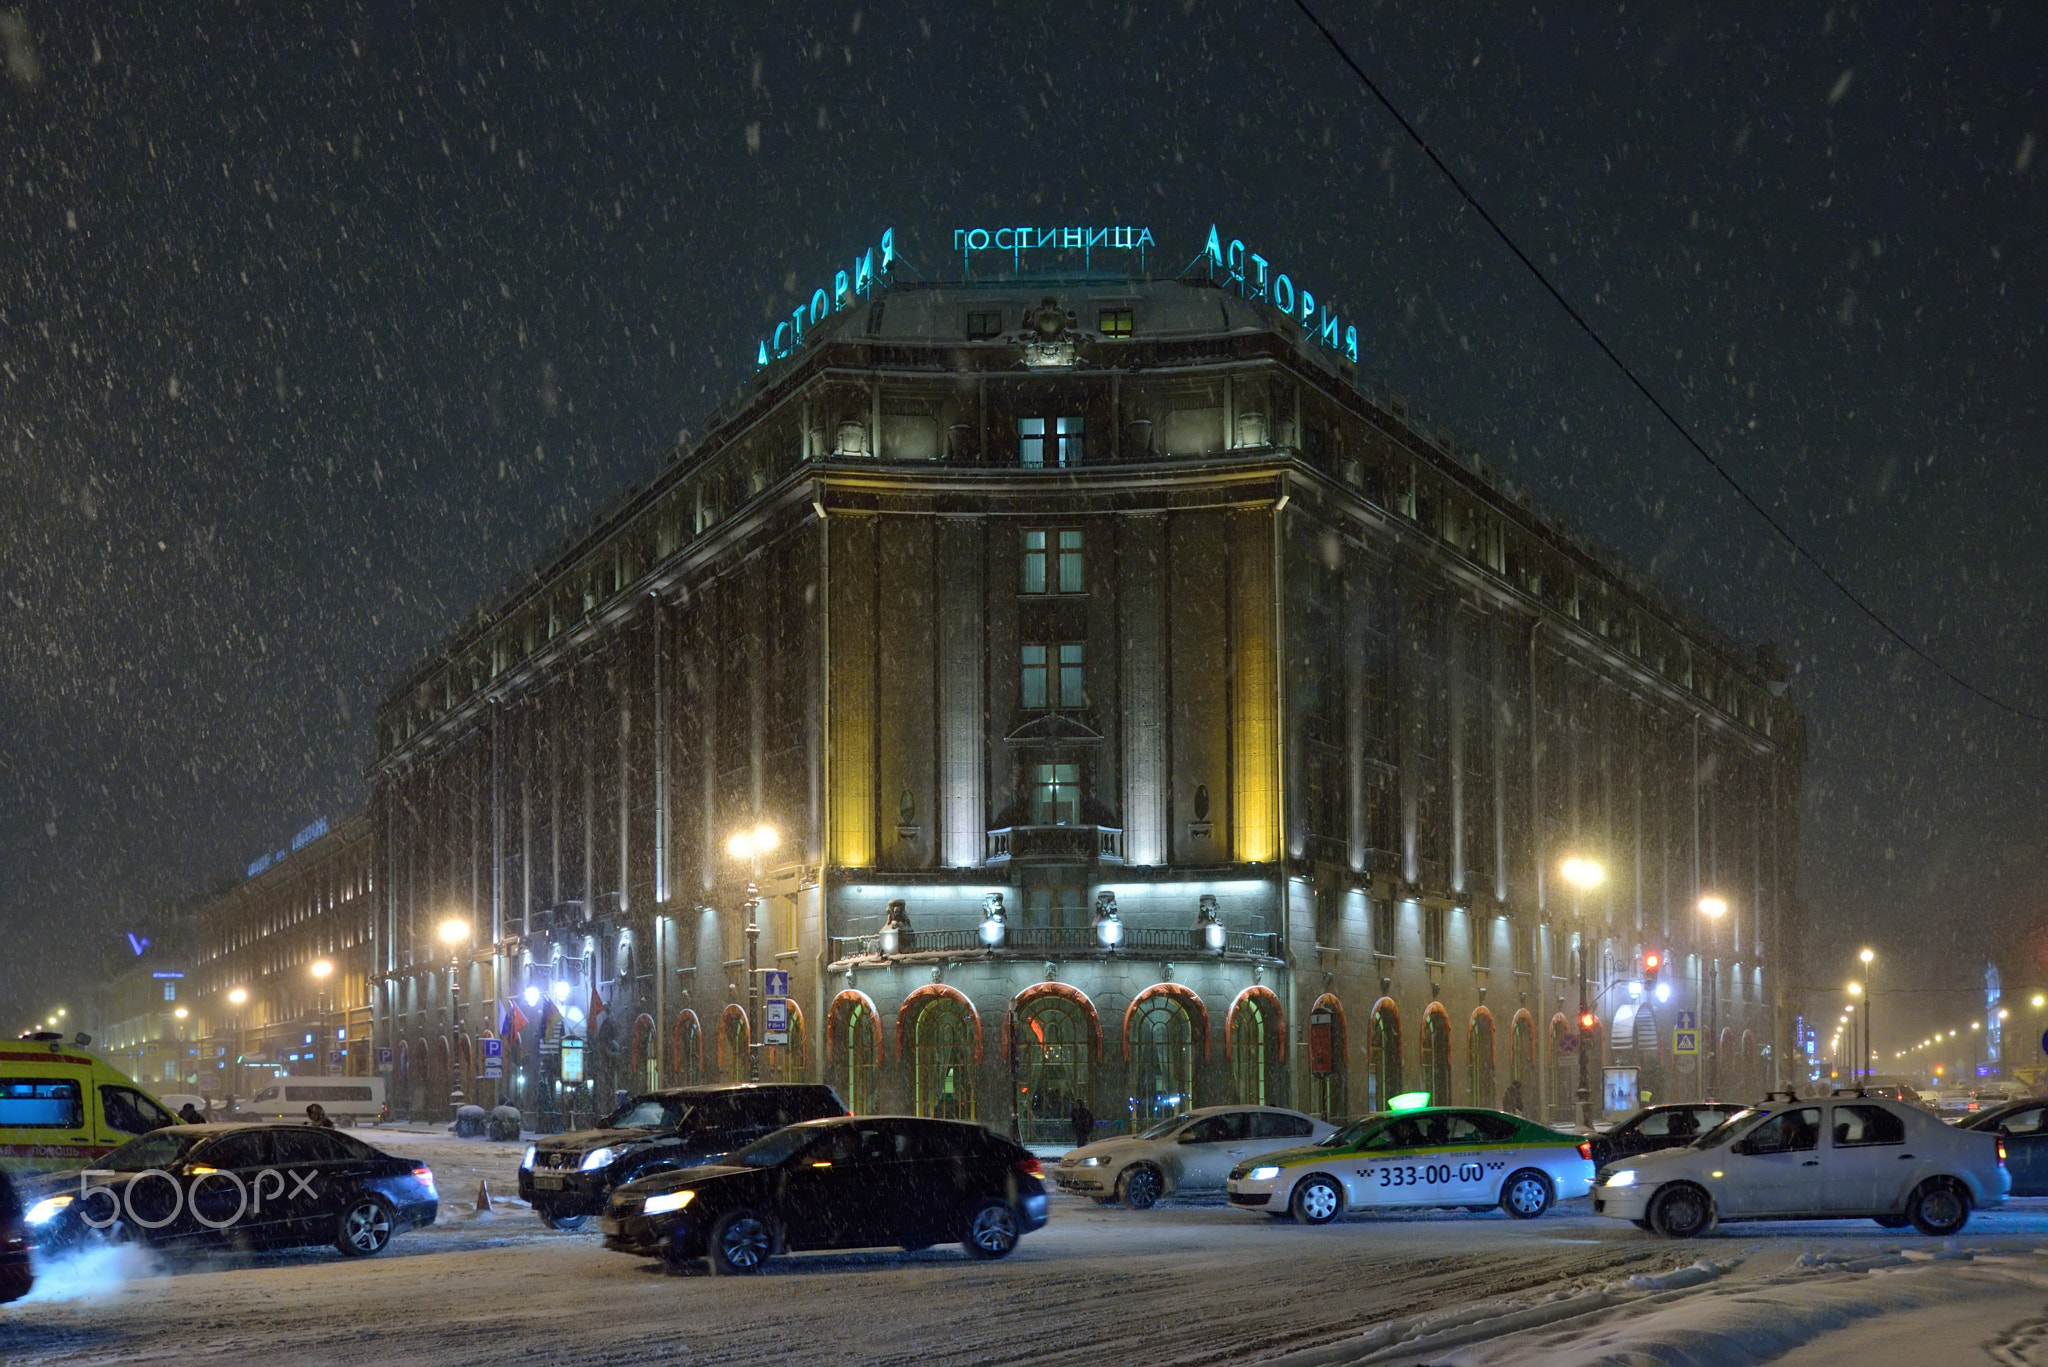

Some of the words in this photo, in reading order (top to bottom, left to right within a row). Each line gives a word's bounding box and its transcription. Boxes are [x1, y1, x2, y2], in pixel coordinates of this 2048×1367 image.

[954, 226, 1155, 250] ГОСТИНИЦА
[757, 226, 893, 368] АСТОРИЯ
[1205, 223, 1358, 363] АСТОРИЯ
[488, 1041, 499, 1055] P
[31, 1146, 80, 1157] ПОМОЩЬ
[1380, 1163, 1483, 1187] 333-00-00
